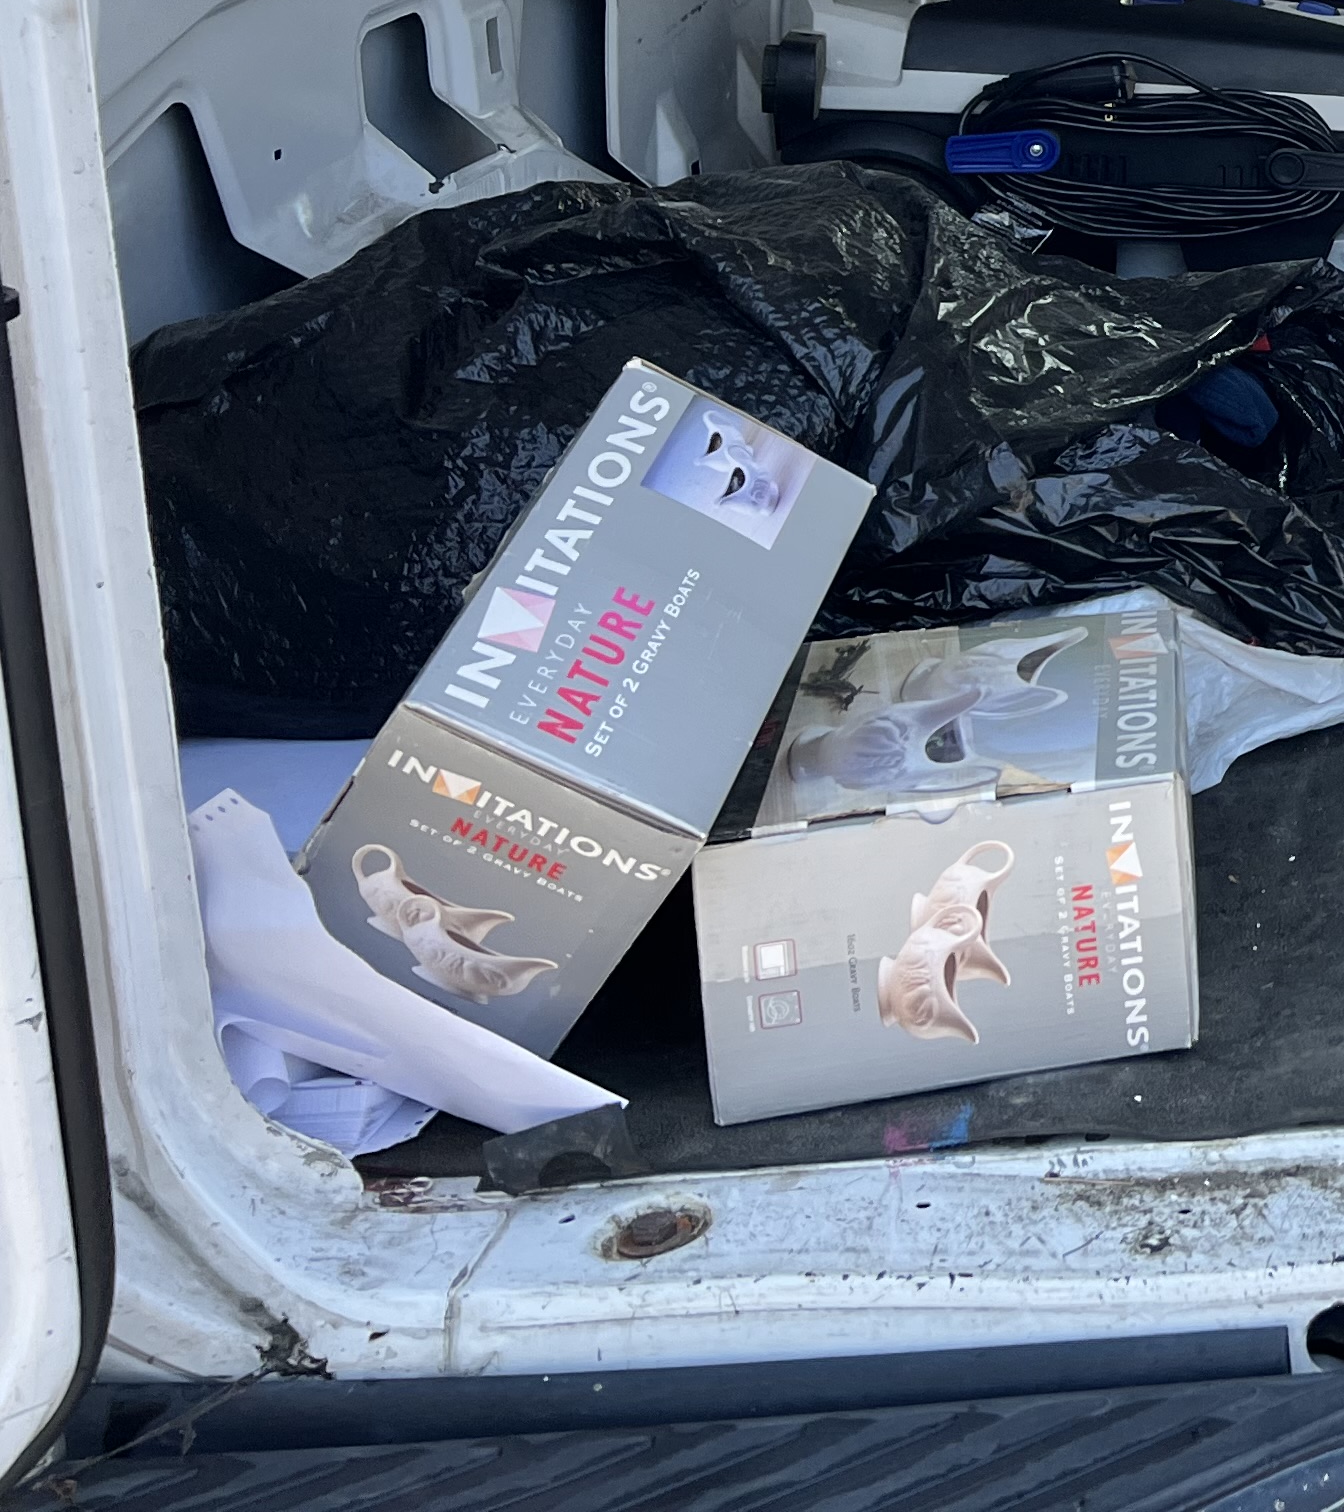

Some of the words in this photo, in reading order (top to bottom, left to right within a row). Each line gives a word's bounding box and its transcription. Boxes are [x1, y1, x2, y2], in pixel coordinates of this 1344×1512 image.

[509, 602, 592, 726] EVERYDAY
[537, 586, 656, 744] NATURE
[585, 723, 610, 758] SET
[608, 697, 629, 720] OF
[622, 677, 640, 693] 2
[632, 619, 672, 676] GRAVY
[664, 568, 701, 621] BOATS
[409, 819, 438, 837] SET
[442, 834, 463, 846] OF
[466, 845, 478, 855] 2
[482, 853, 531, 878] GRAVY
[536, 877, 583, 902] BOATS
[450, 817, 568, 882] NATURE
[473, 810, 570, 856] EVERYDAY
[1054, 855, 1064, 881] SET
[1056, 888, 1066, 905] OF
[1058, 911, 1067, 920] 2
[1071, 885, 1101, 988] NATURE
[1063, 973, 1075, 1015] BOATS
